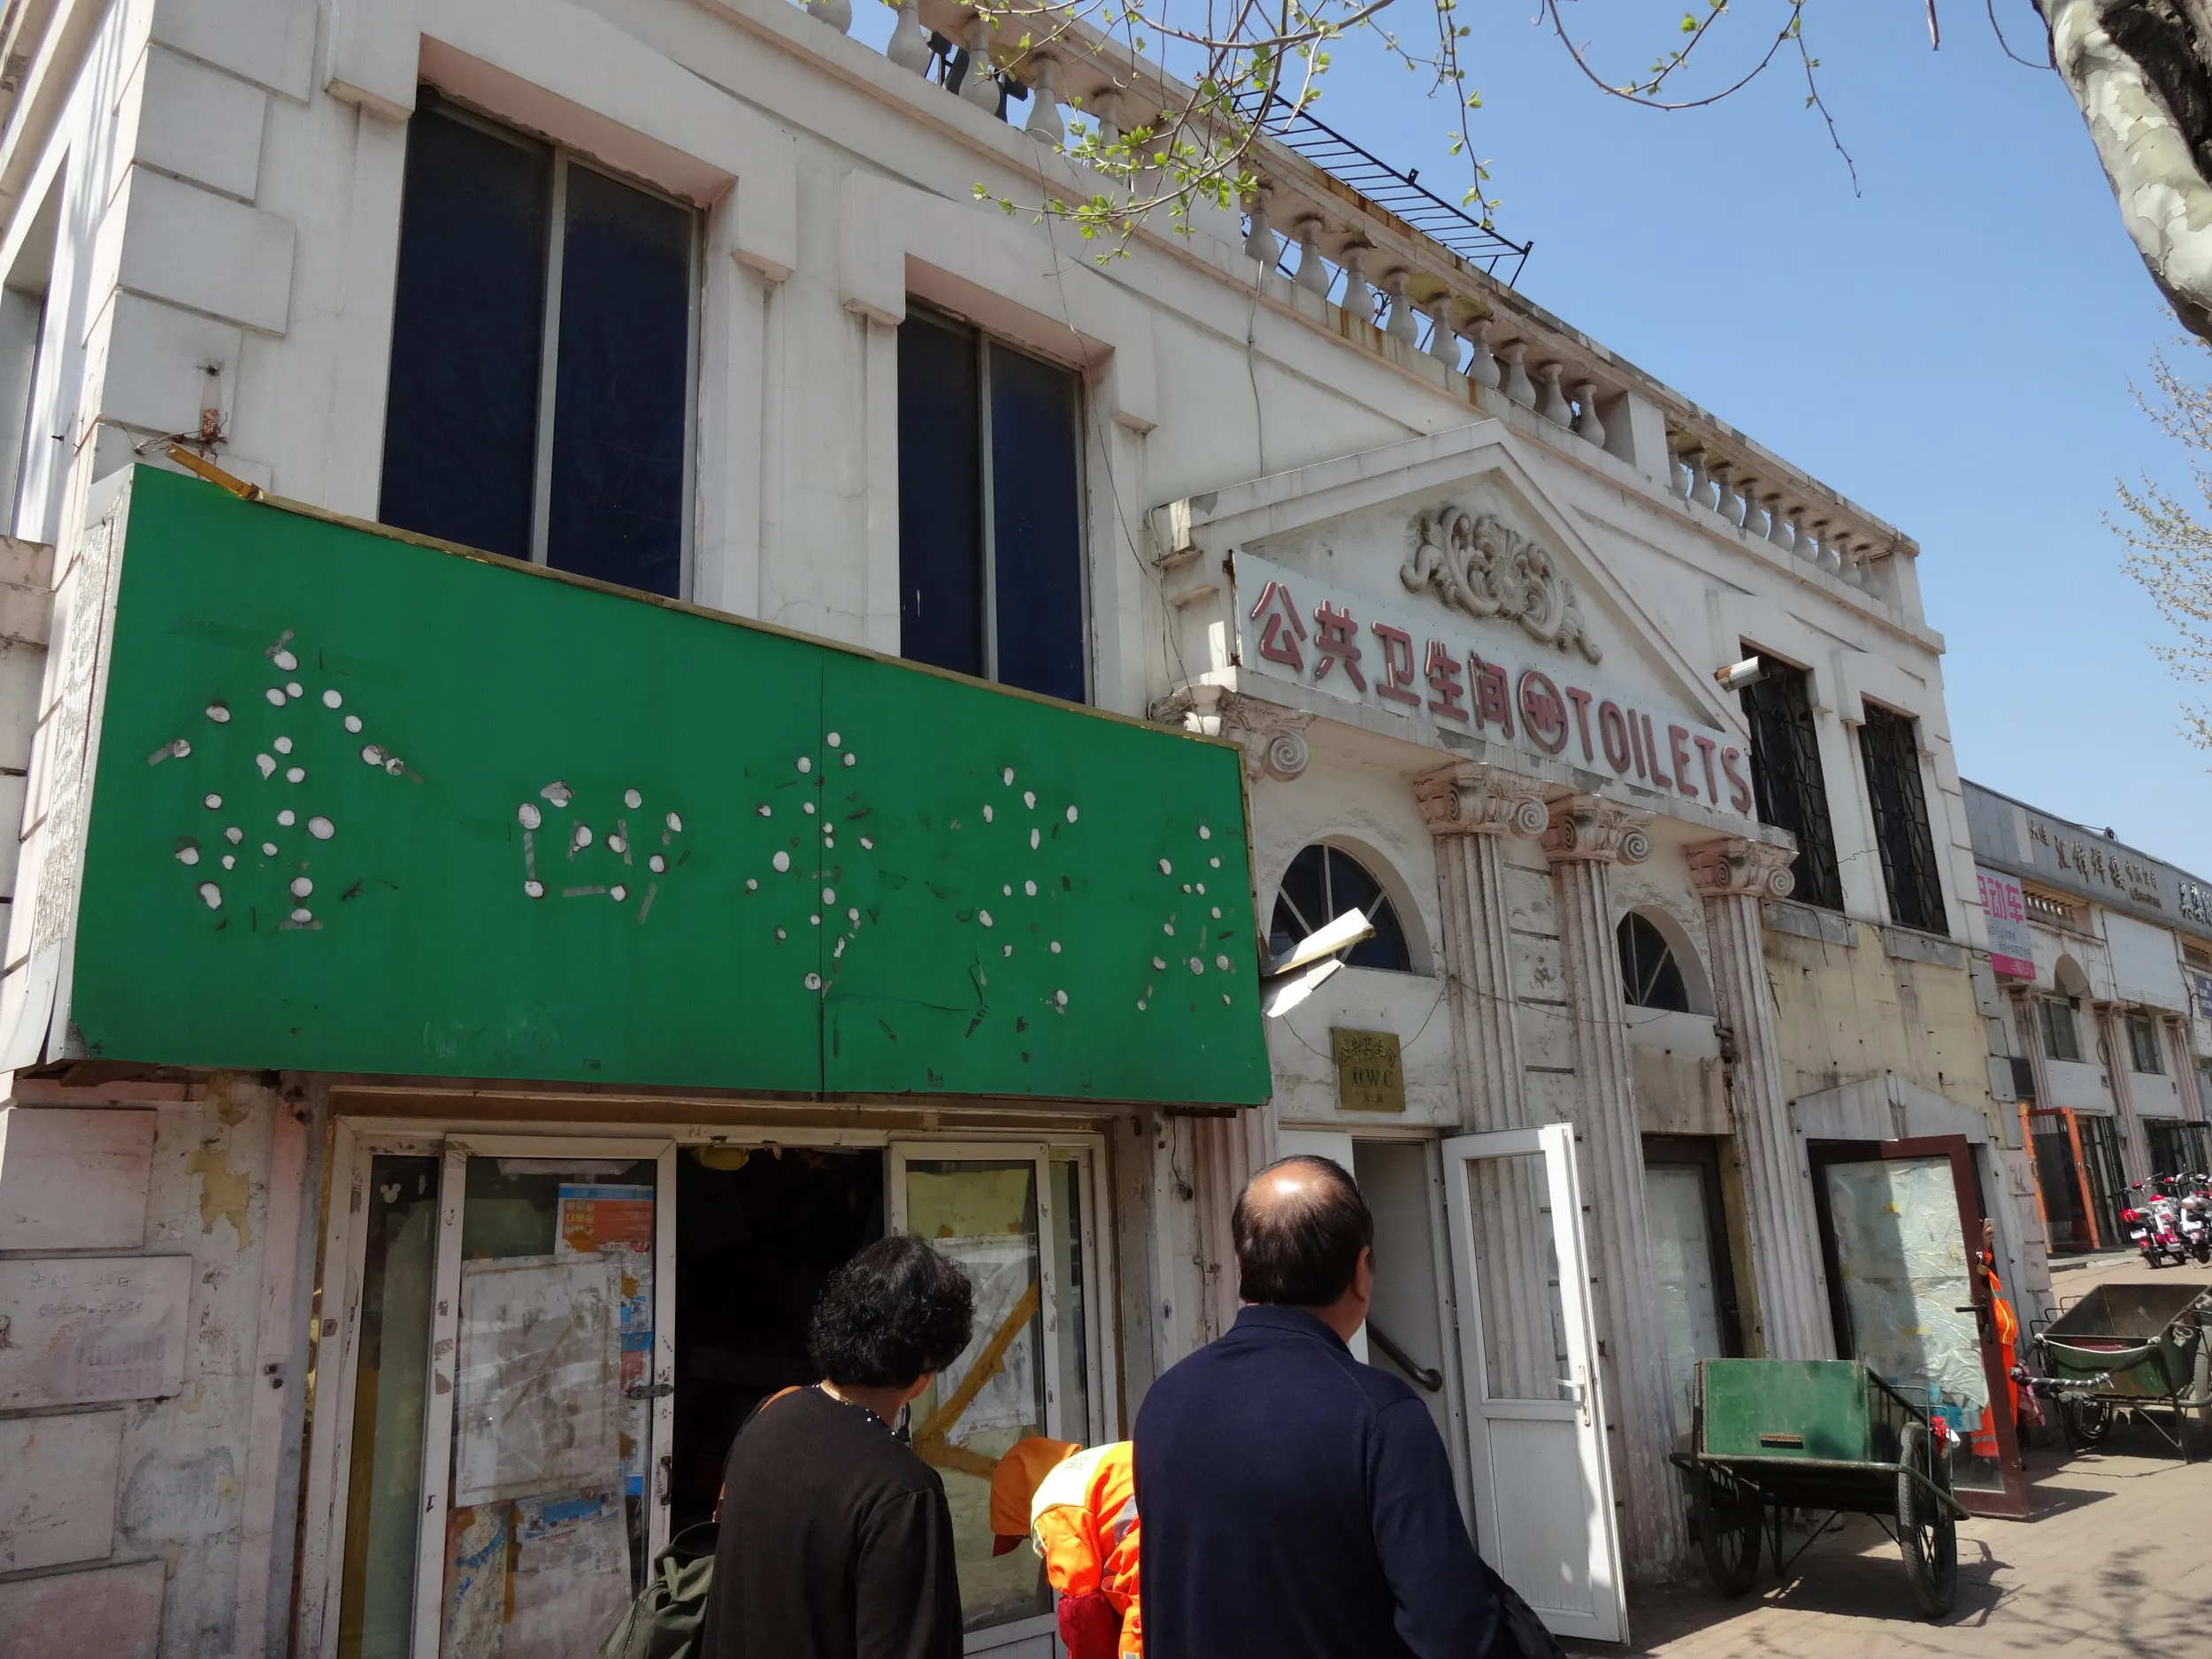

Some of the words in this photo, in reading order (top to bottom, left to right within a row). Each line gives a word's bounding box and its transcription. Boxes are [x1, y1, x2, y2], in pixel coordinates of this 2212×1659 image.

[1251, 580, 1516, 741] 公共卫生间
[1567, 685, 1754, 814] TOILETS
[1340, 1036, 1397, 1069] 公共卫生间
